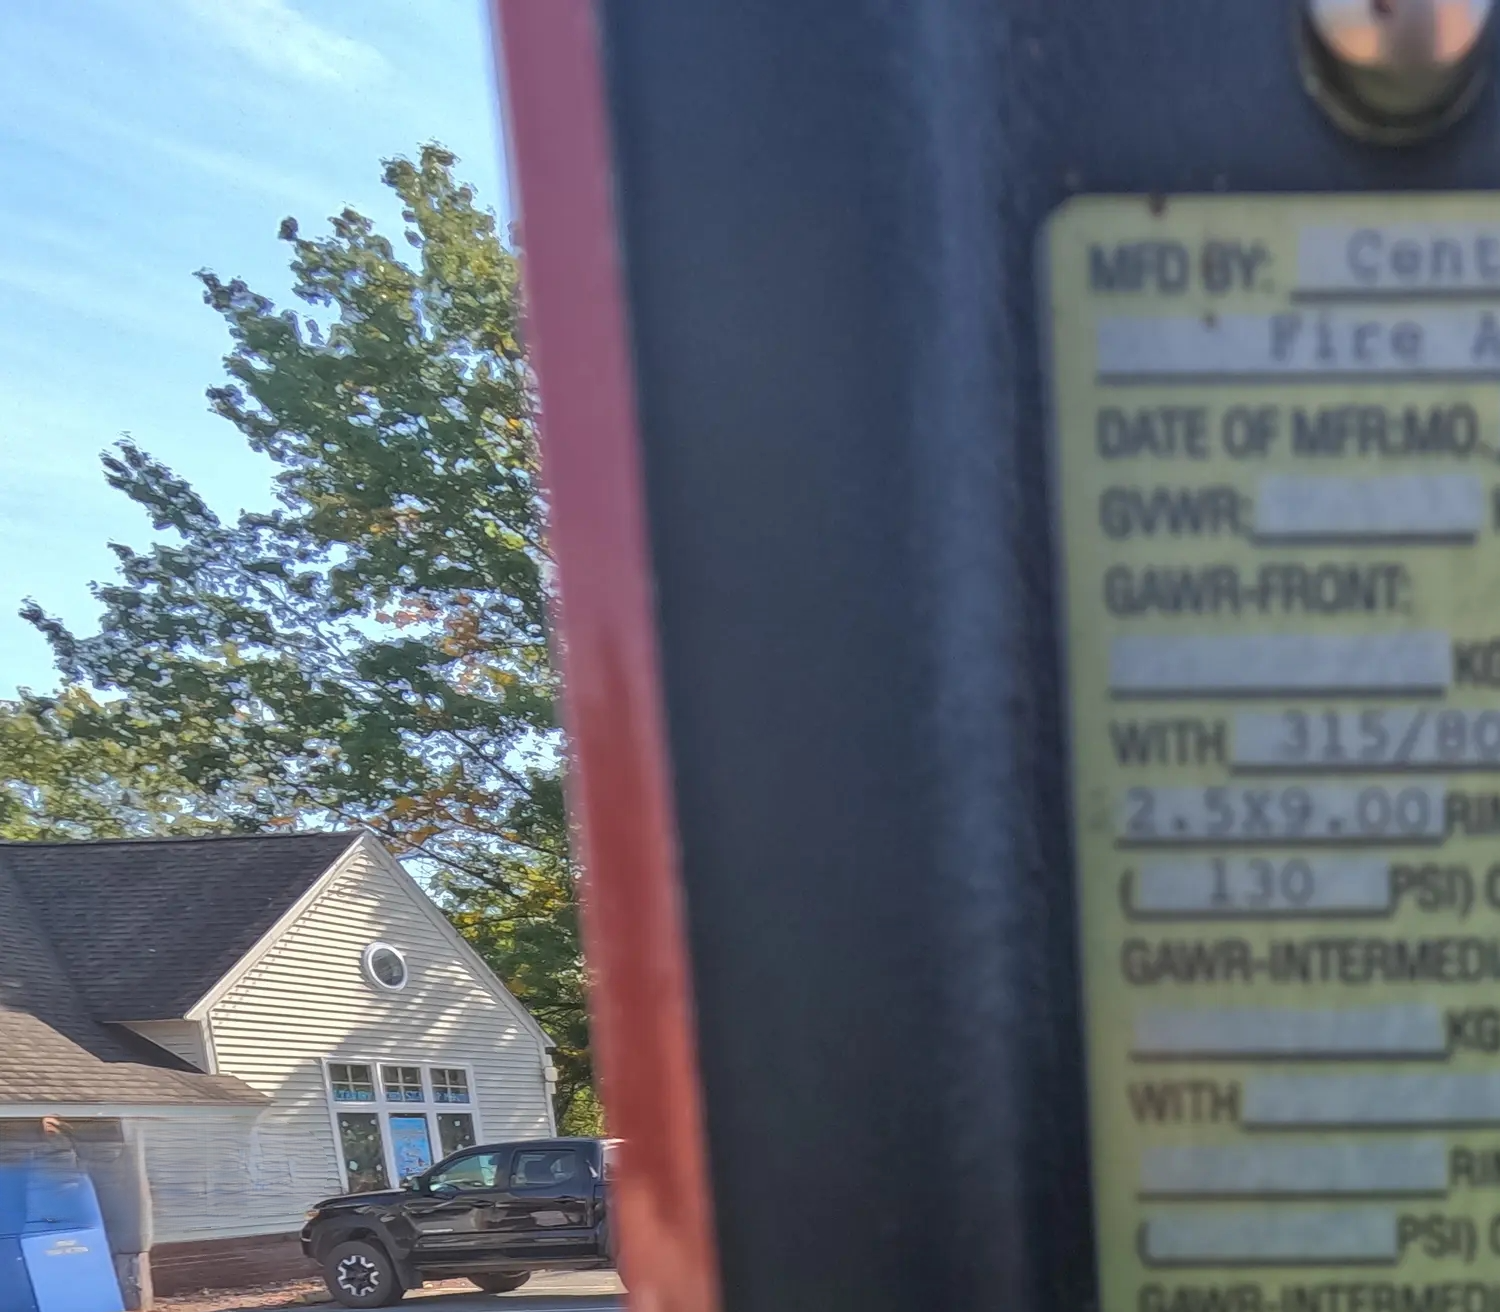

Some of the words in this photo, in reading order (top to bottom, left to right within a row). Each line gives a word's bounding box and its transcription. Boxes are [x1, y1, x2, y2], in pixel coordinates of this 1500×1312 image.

[1088, 240, 1189, 293] MFD
[1269, 311, 1424, 361] Fire
[1094, 405, 1210, 459] DATE
[1222, 404, 1280, 458] OF
[1108, 718, 1228, 767] WITH
[1087, 785, 1432, 836] 2.5X9.00
[1209, 858, 1316, 907] 130
[1125, 1077, 1243, 1125] WITH
